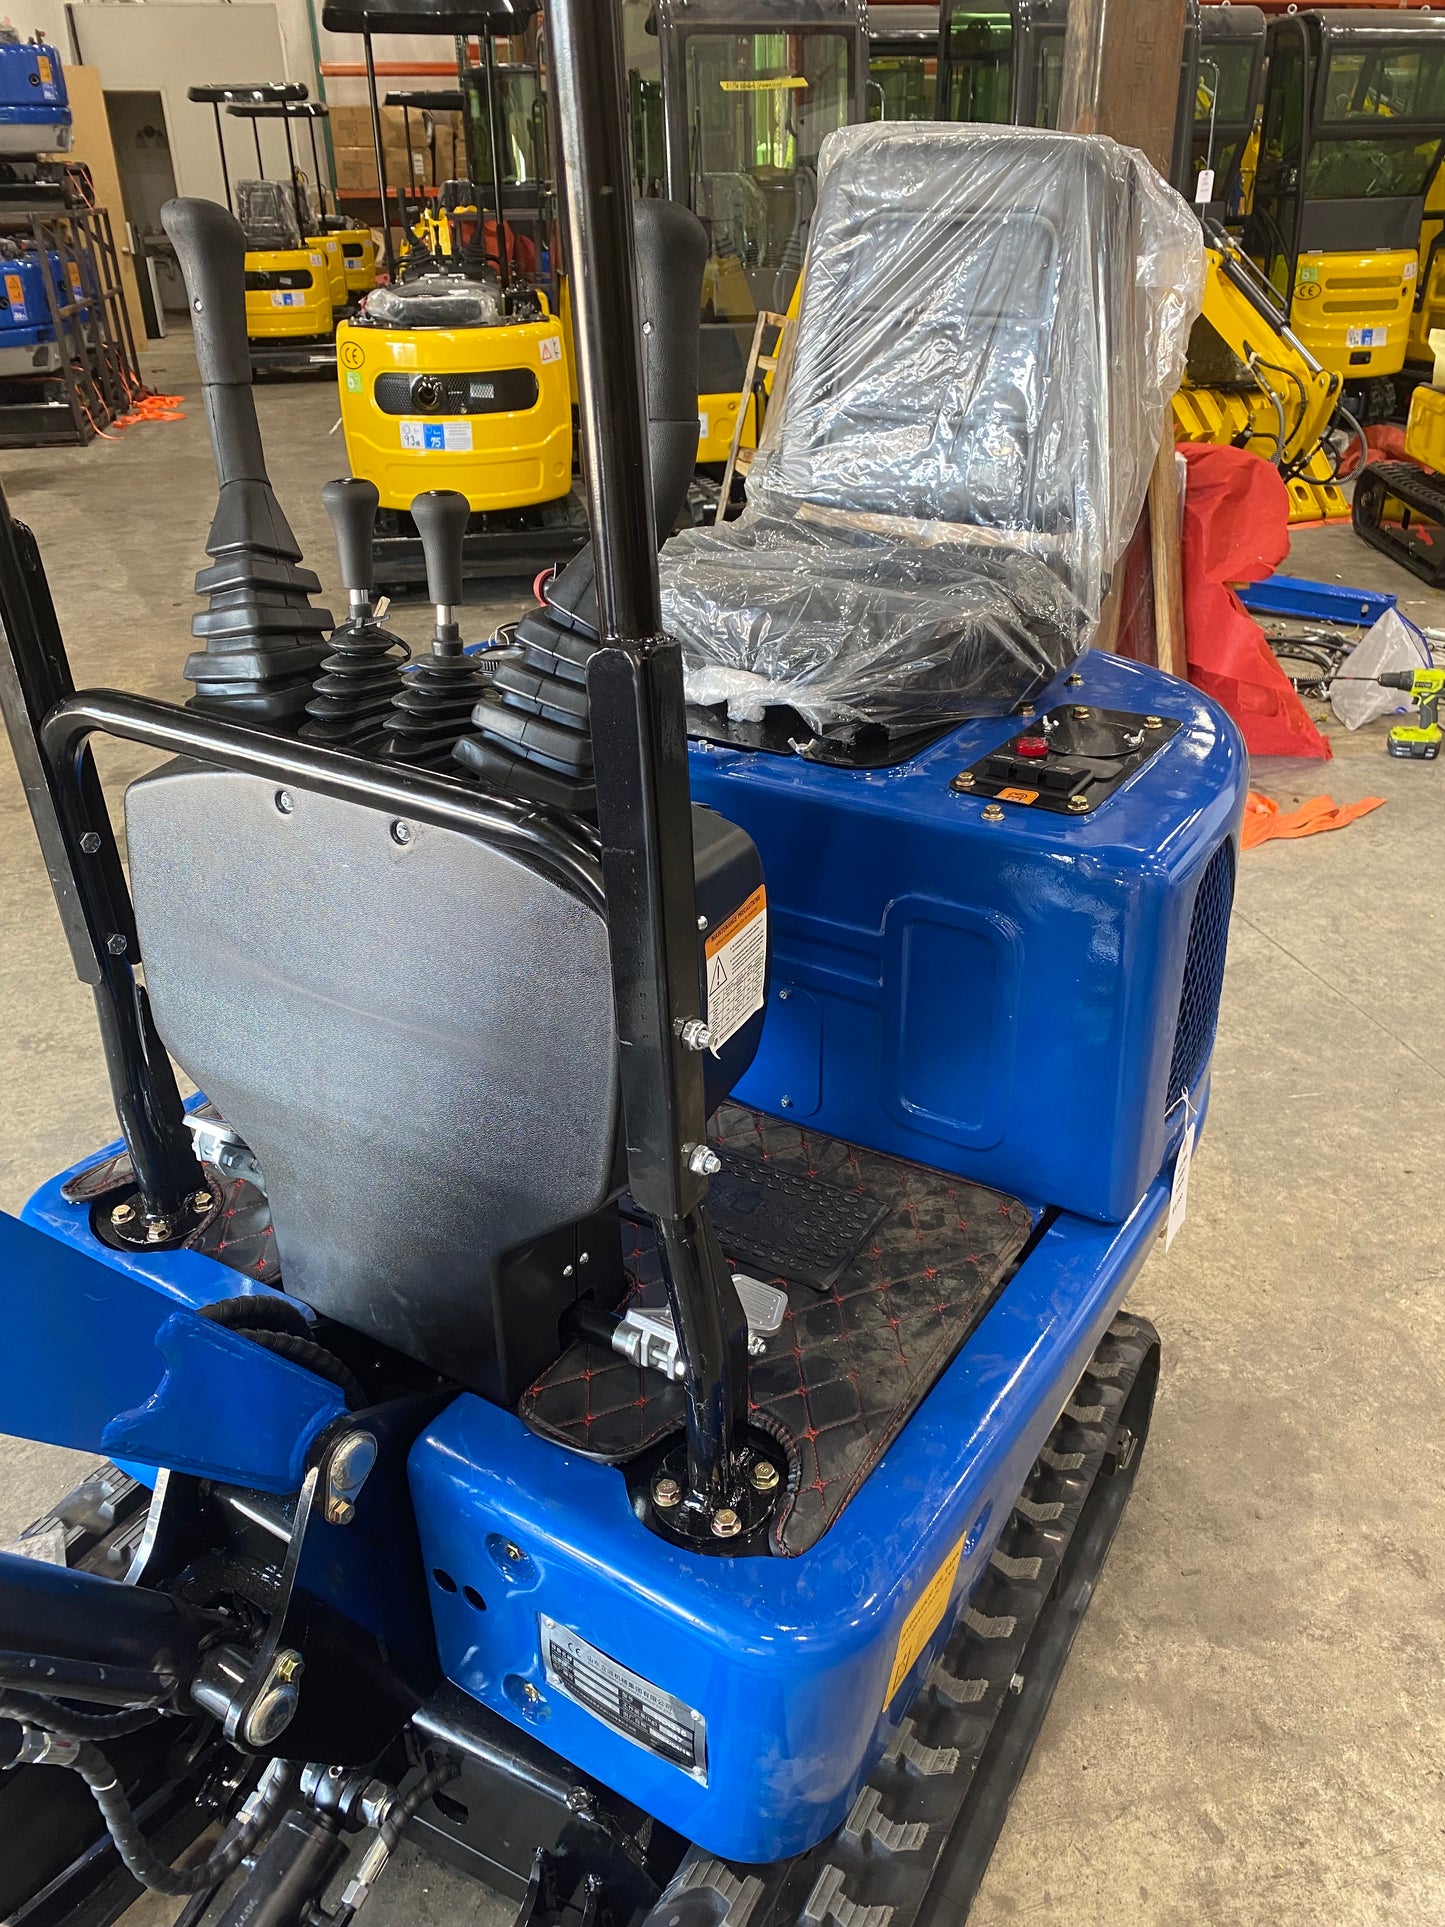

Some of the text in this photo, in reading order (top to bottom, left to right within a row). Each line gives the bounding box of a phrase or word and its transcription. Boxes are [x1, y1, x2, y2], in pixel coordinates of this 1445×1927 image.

[344, 347, 359, 365] CE
[430, 437, 441, 447] 75
[567, 1642, 582, 1658] CE
